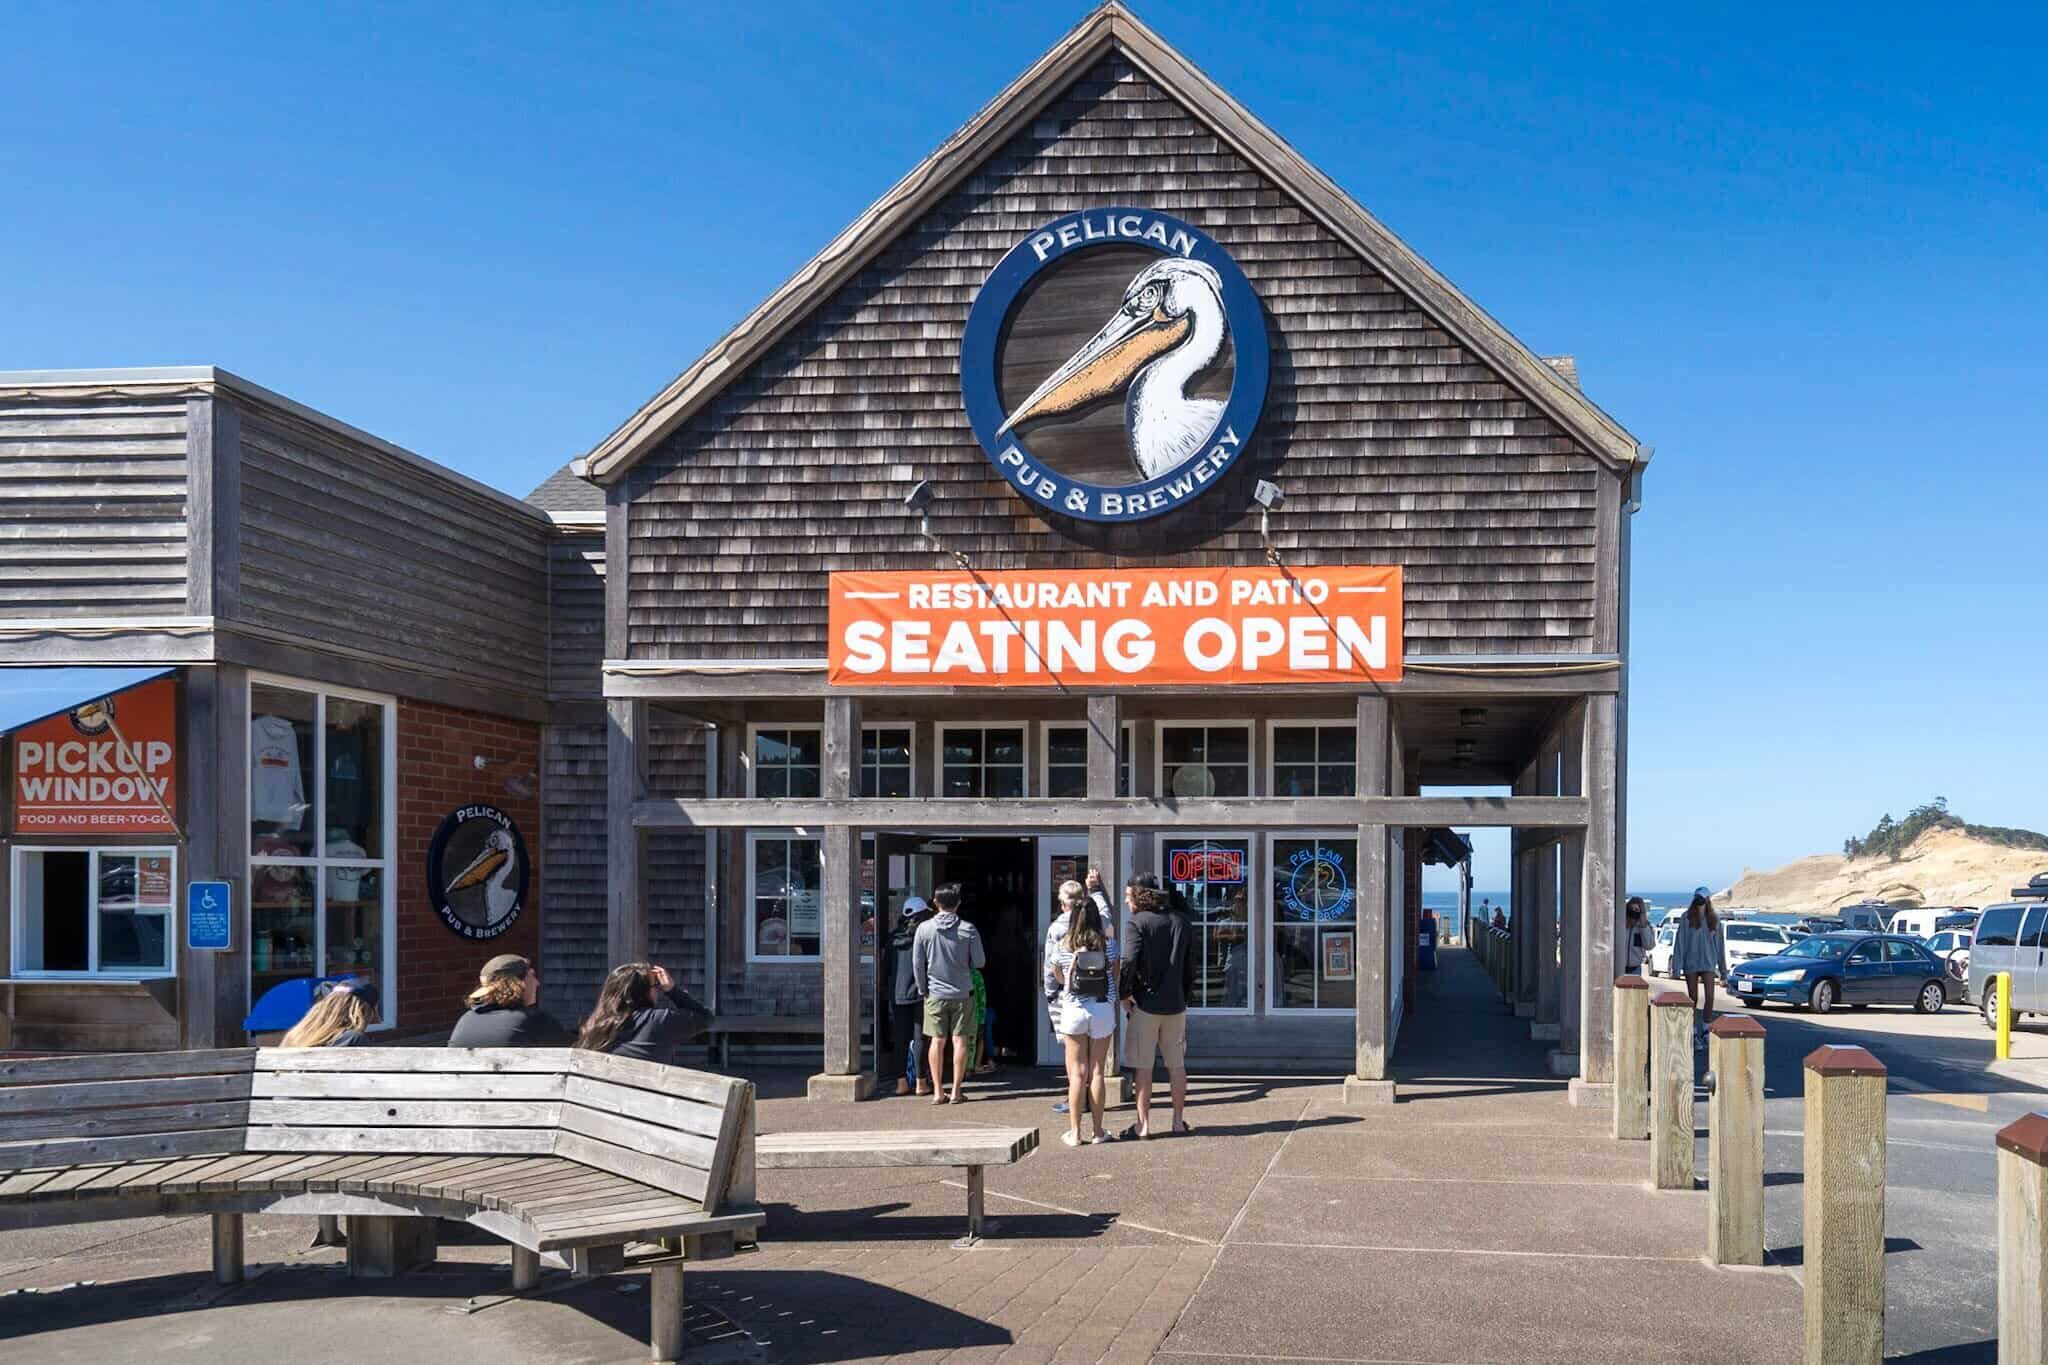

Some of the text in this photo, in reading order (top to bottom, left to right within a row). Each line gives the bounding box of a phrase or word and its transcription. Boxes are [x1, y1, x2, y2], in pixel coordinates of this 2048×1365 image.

[1028, 215, 1199, 261] PELICAN
[999, 426, 1241, 516] PUB & BREWERY
[908, 578, 1329, 609] RESTAURANT AND PATIO
[842, 615, 1388, 675] SEATING OPEN
[19, 741, 172, 774] PICKUP
[19, 777, 169, 802] WINDOW
[19, 815, 56, 824] FOOD
[58, 815, 87, 824] AND
[456, 806, 512, 829] PELICAN
[1173, 852, 1240, 880] OPEN
[1290, 848, 1343, 866] PELCAN
[441, 902, 521, 938] PUB & BREWERY
